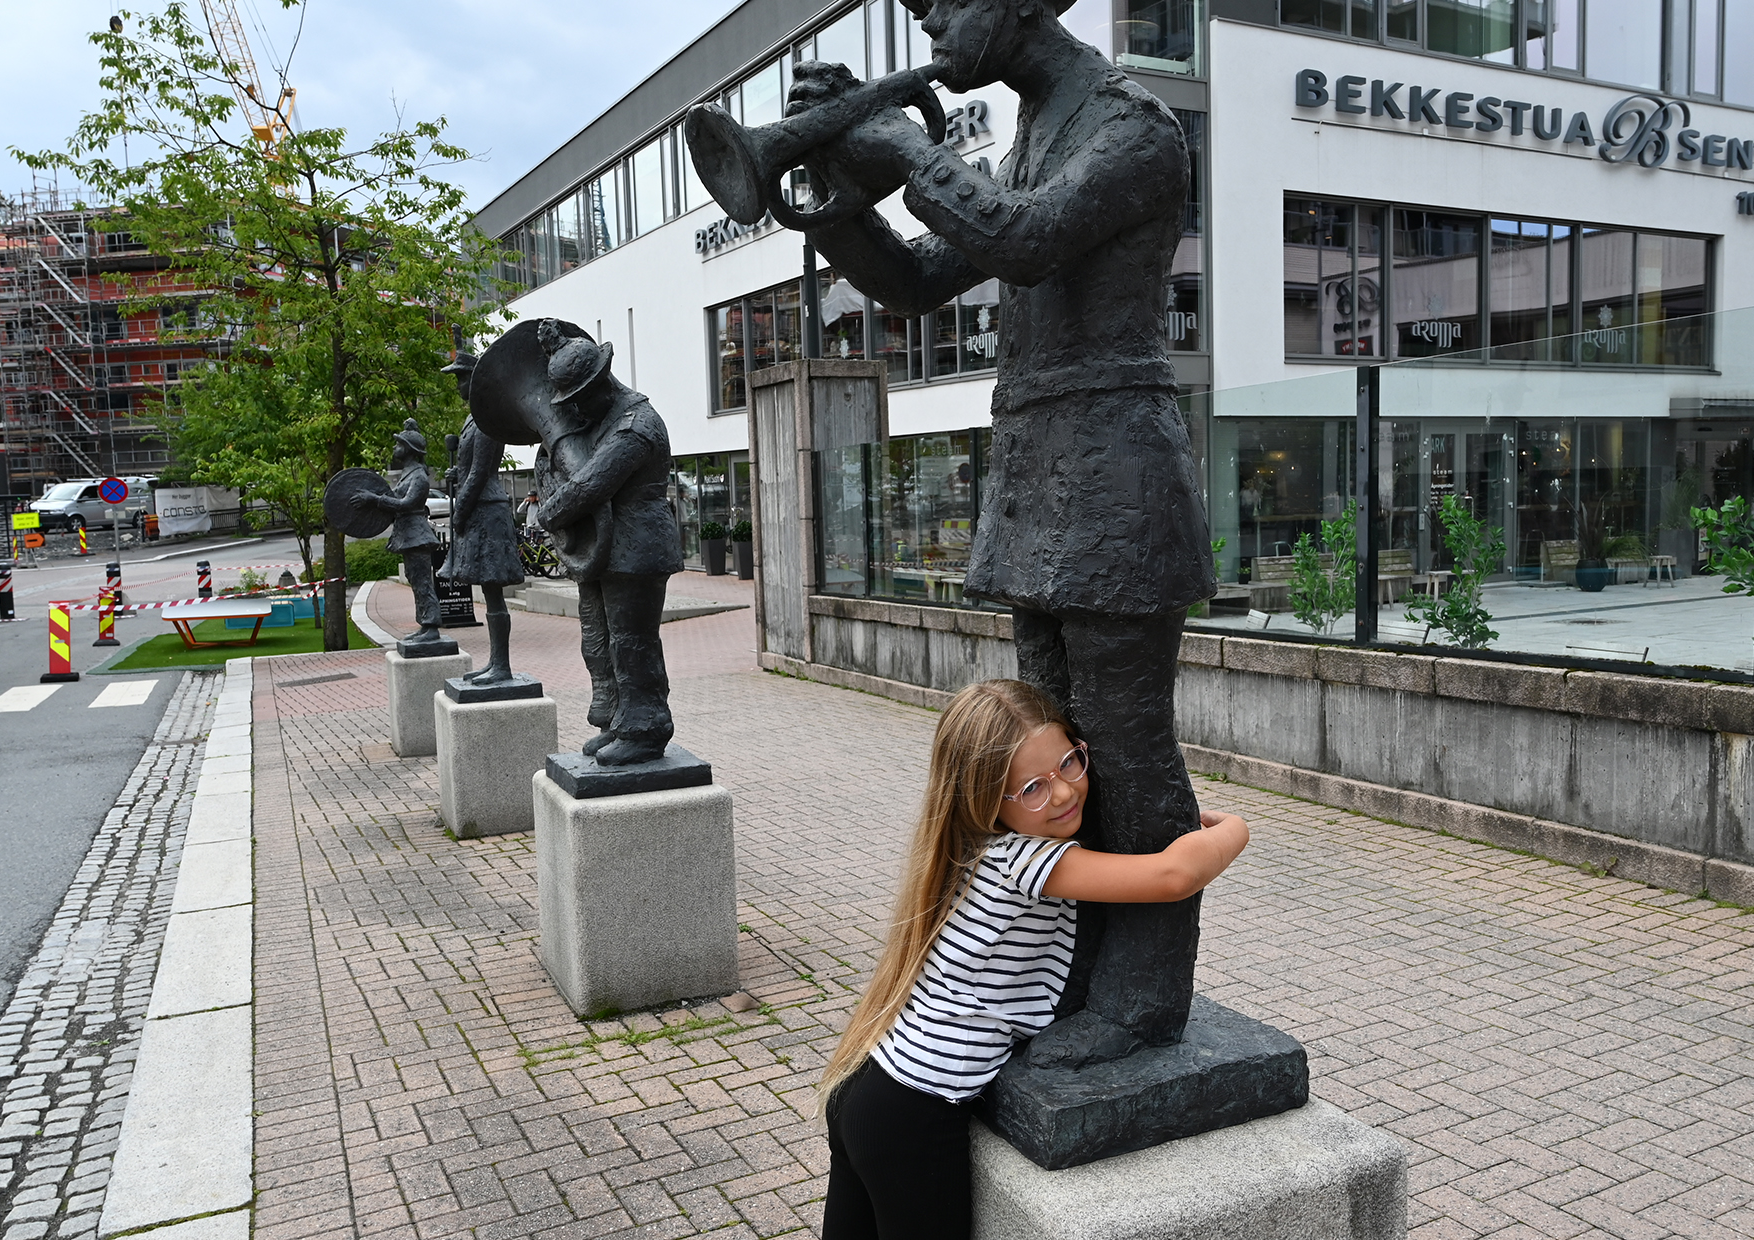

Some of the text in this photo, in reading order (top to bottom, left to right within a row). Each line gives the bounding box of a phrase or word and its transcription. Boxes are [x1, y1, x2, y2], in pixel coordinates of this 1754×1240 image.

[1295, 68, 1596, 148] BEKKESTUA
[1411, 320, 1463, 348] aroma
[1584, 328, 1626, 354] aroma
